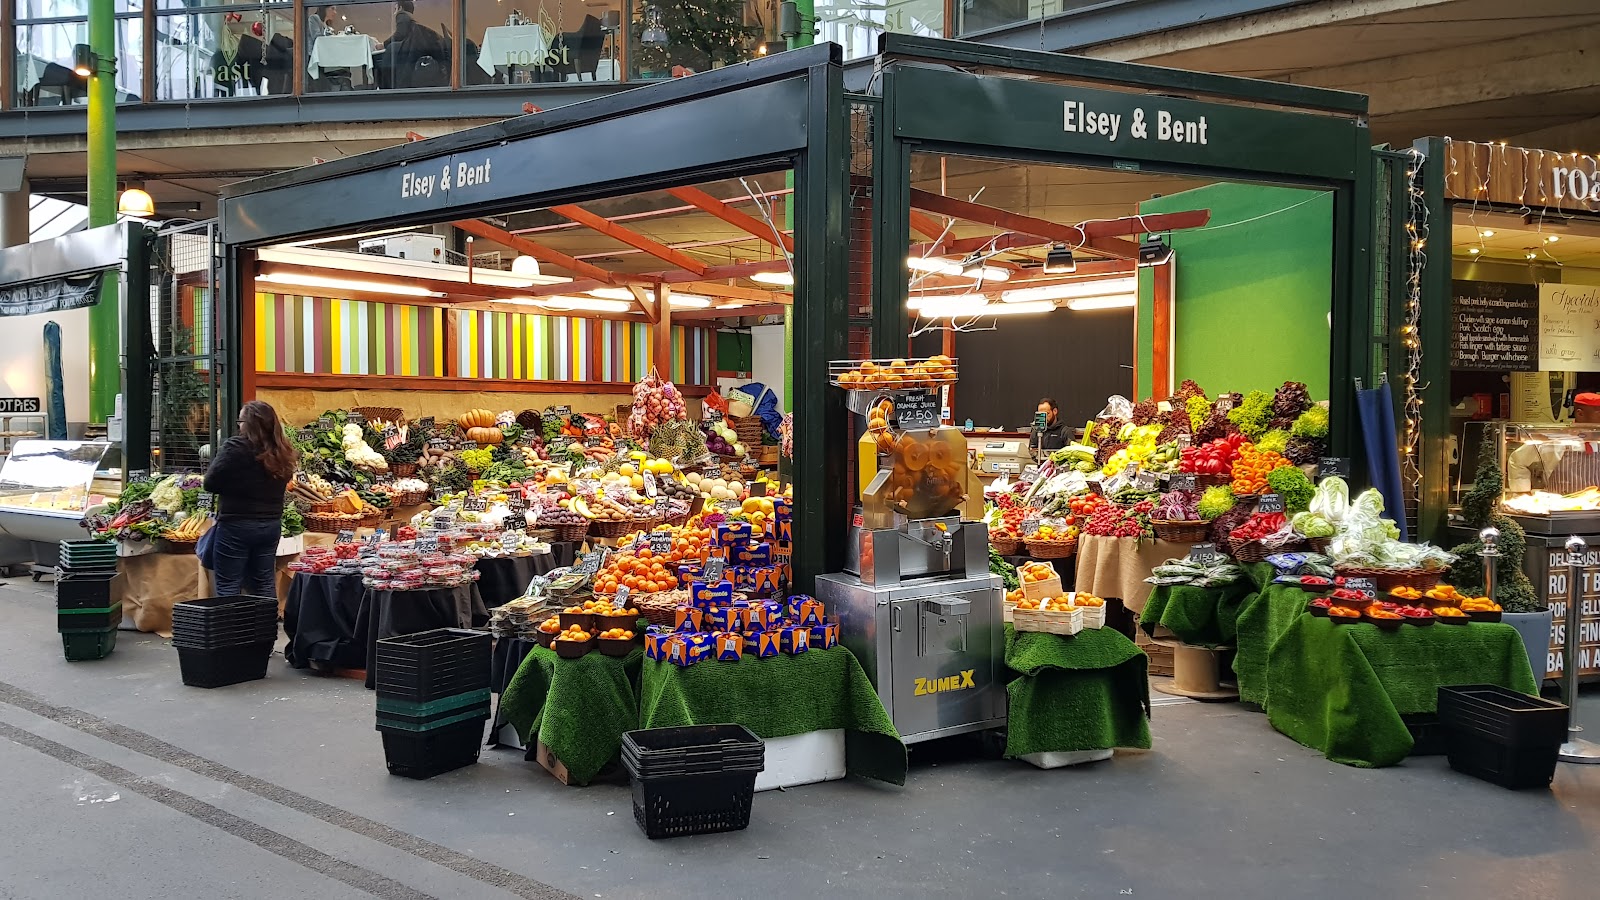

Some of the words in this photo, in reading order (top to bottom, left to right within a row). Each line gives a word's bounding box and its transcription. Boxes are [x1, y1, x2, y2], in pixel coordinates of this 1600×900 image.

[506, 44, 570, 67] roast
[1063, 100, 1121, 142] Elsey
[1130, 107, 1147, 139] &
[1157, 110, 1208, 145] Bent
[401, 172, 436, 198] Elsey
[440, 165, 451, 191] &
[456, 158, 491, 188] Bent
[1472, 323, 1491, 333] Scotch
[1493, 326, 1505, 335] egg
[914, 669, 976, 696] ZUMEX
